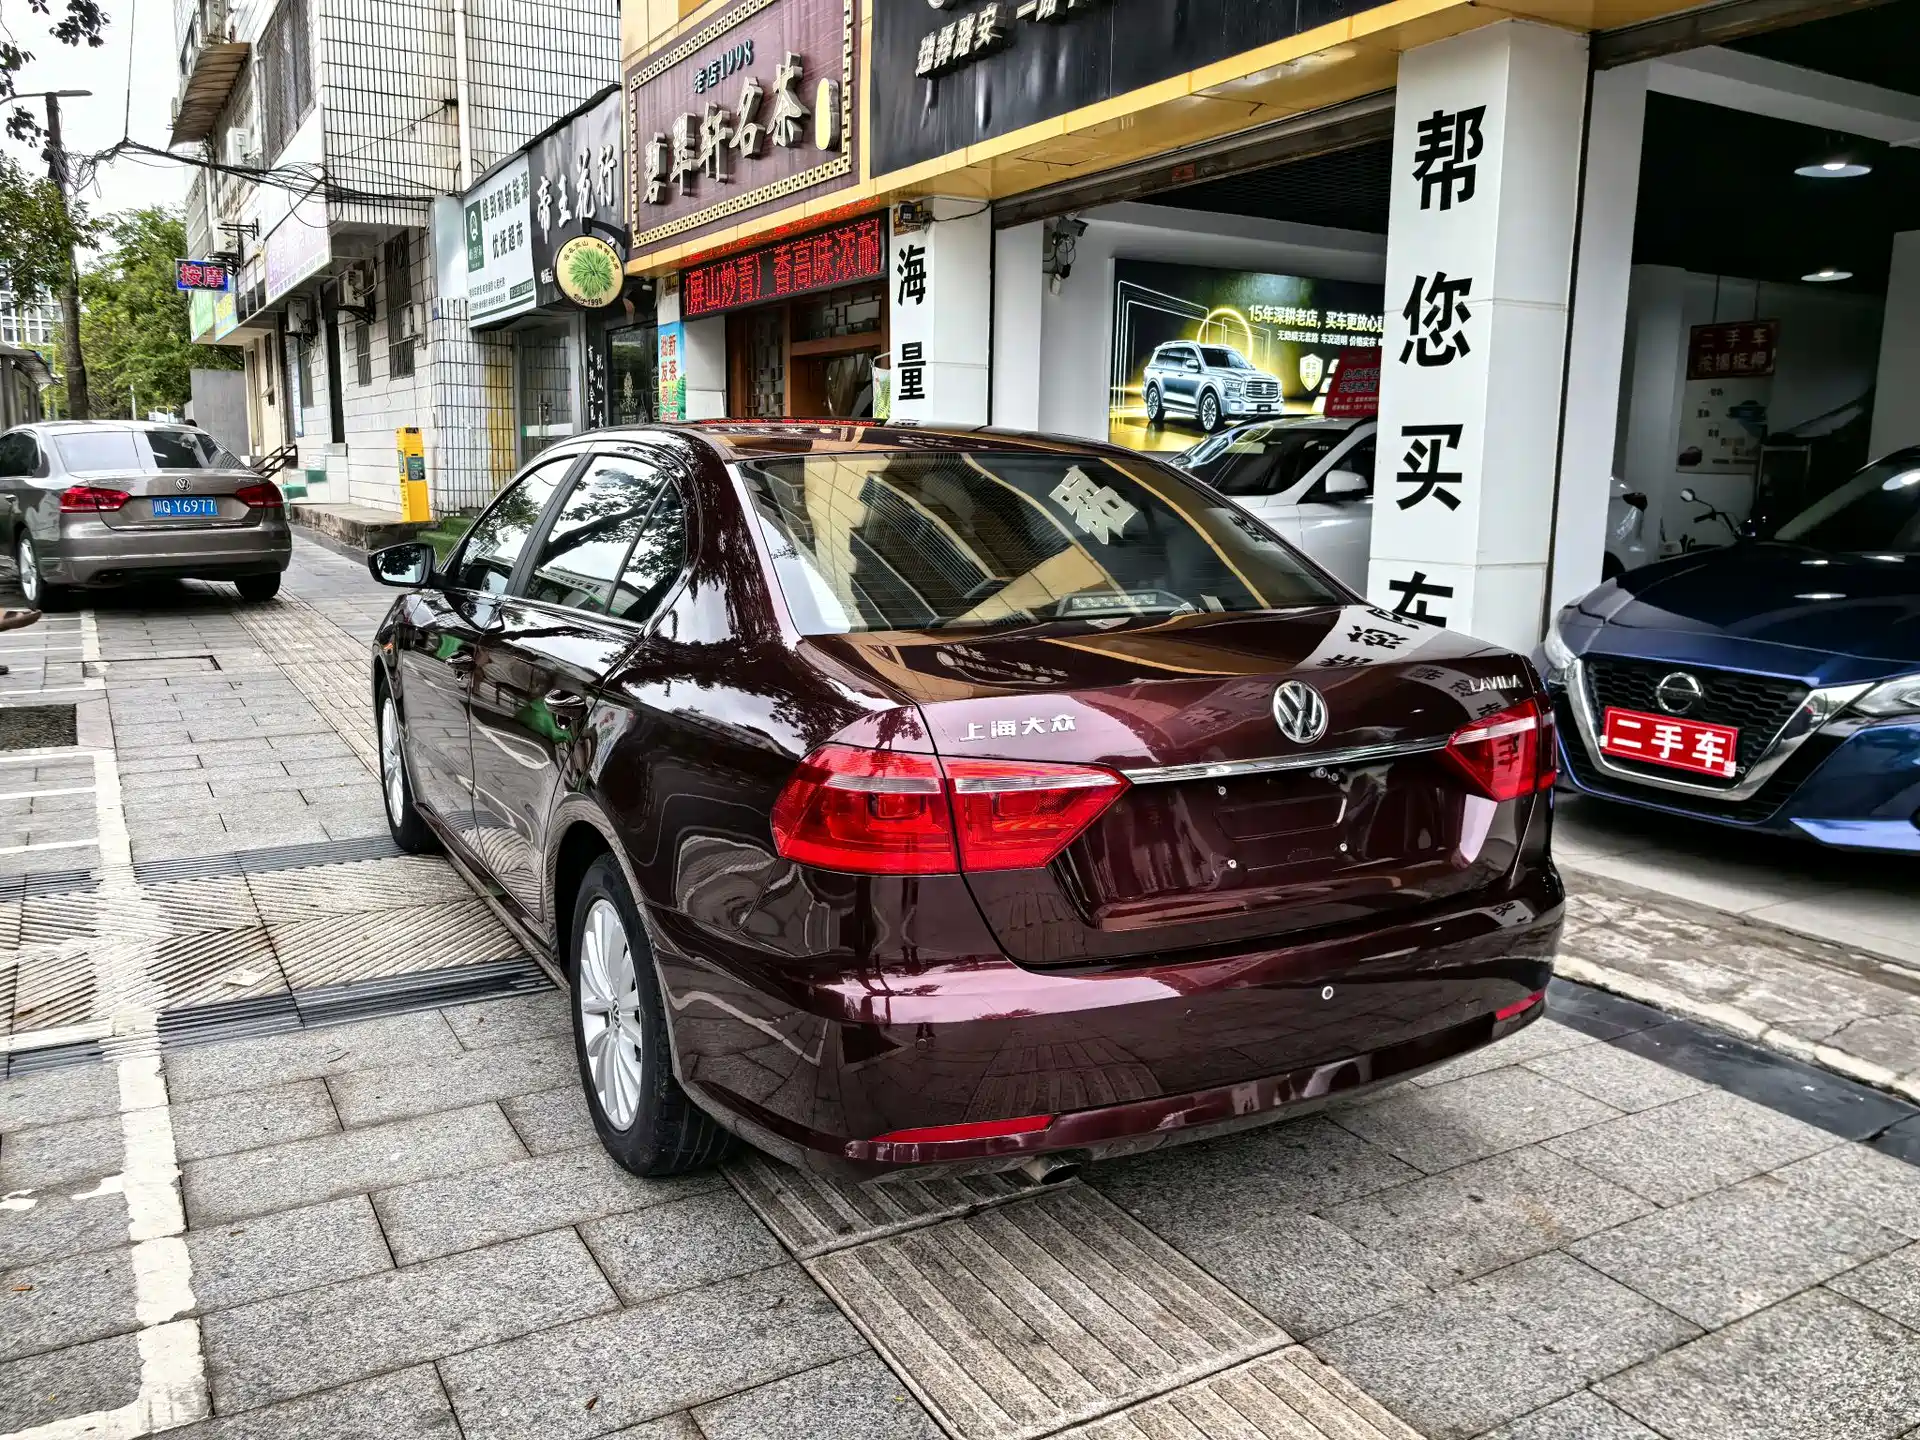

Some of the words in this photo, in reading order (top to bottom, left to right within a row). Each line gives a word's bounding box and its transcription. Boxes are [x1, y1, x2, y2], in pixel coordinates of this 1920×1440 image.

[694, 39, 755, 94] 老店1998
[537, 144, 618, 244] 帝王花行
[180, 263, 224, 287] 按摩
[897, 244, 927, 401] 海量
[1700, 328, 1769, 348] 二手车
[1388, 104, 1487, 628] 帮您买车
[958, 713, 1076, 742] 上海大众
[1612, 718, 1726, 768] 二手车
